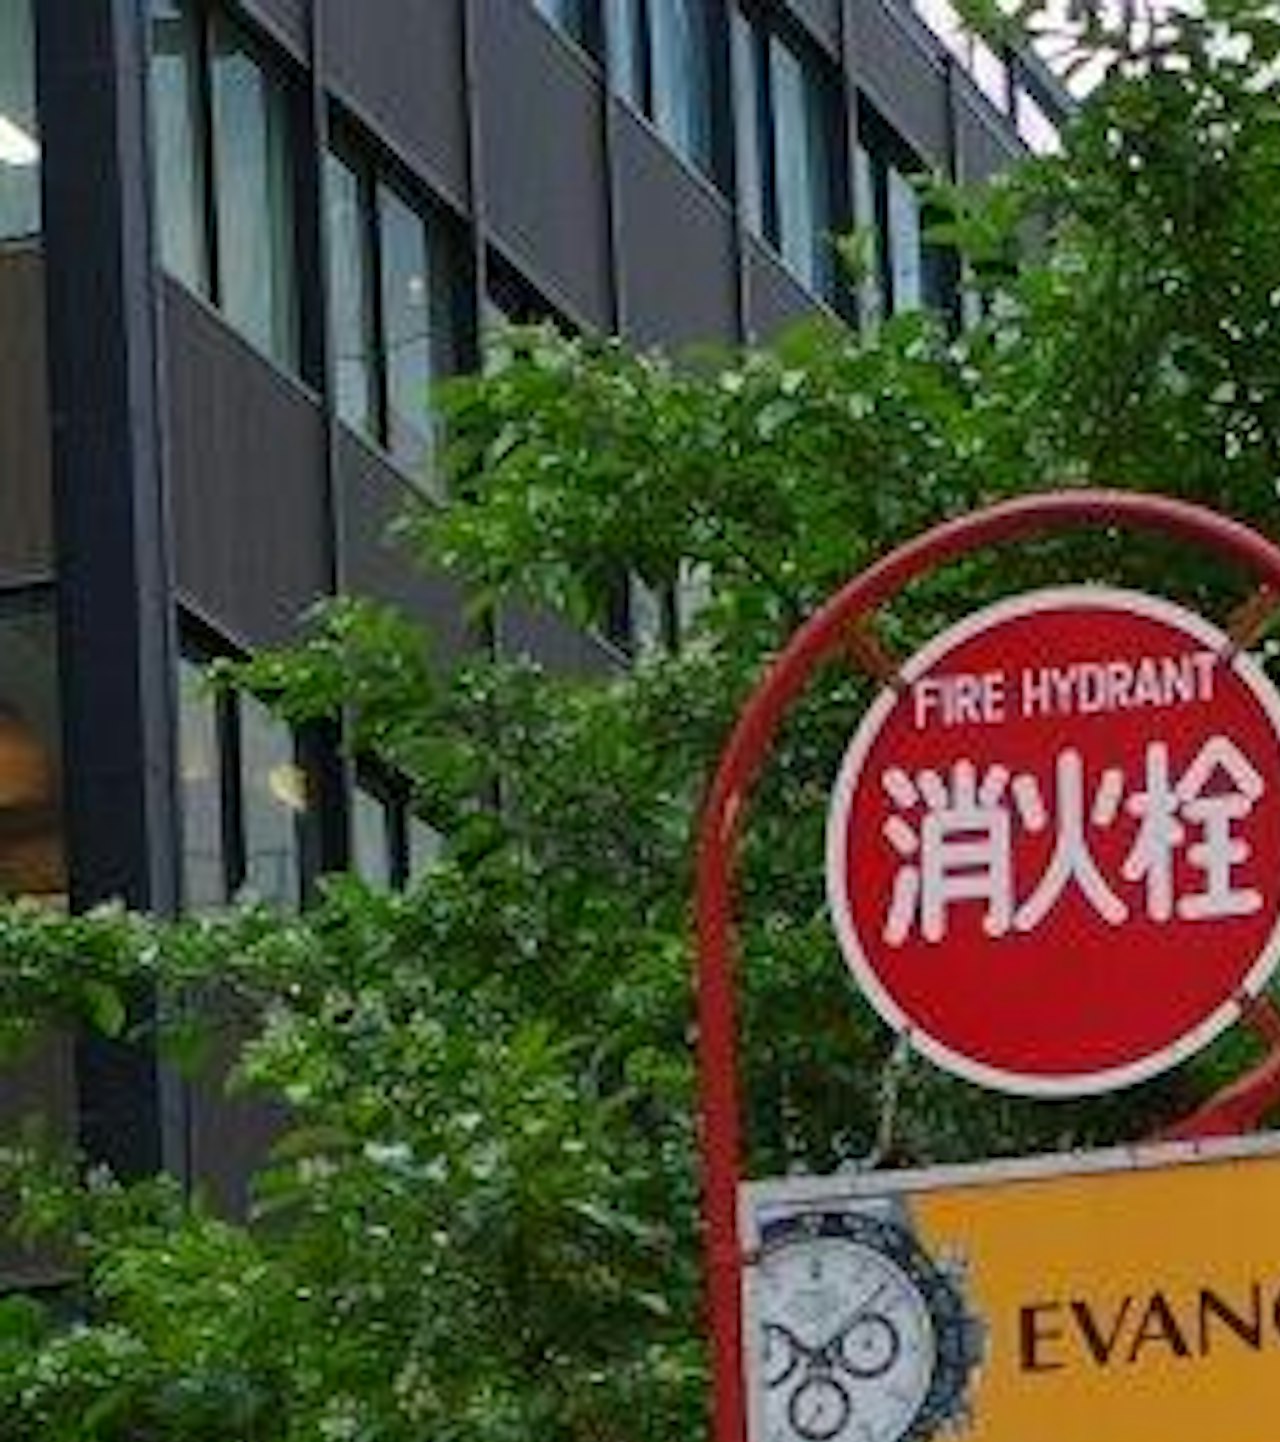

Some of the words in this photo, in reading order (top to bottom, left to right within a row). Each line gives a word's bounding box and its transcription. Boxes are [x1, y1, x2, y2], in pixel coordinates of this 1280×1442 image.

[914, 671, 1005, 729] FIRE
[1021, 651, 1217, 717] HYDRANT
[882, 735, 1265, 946] 消火栓
